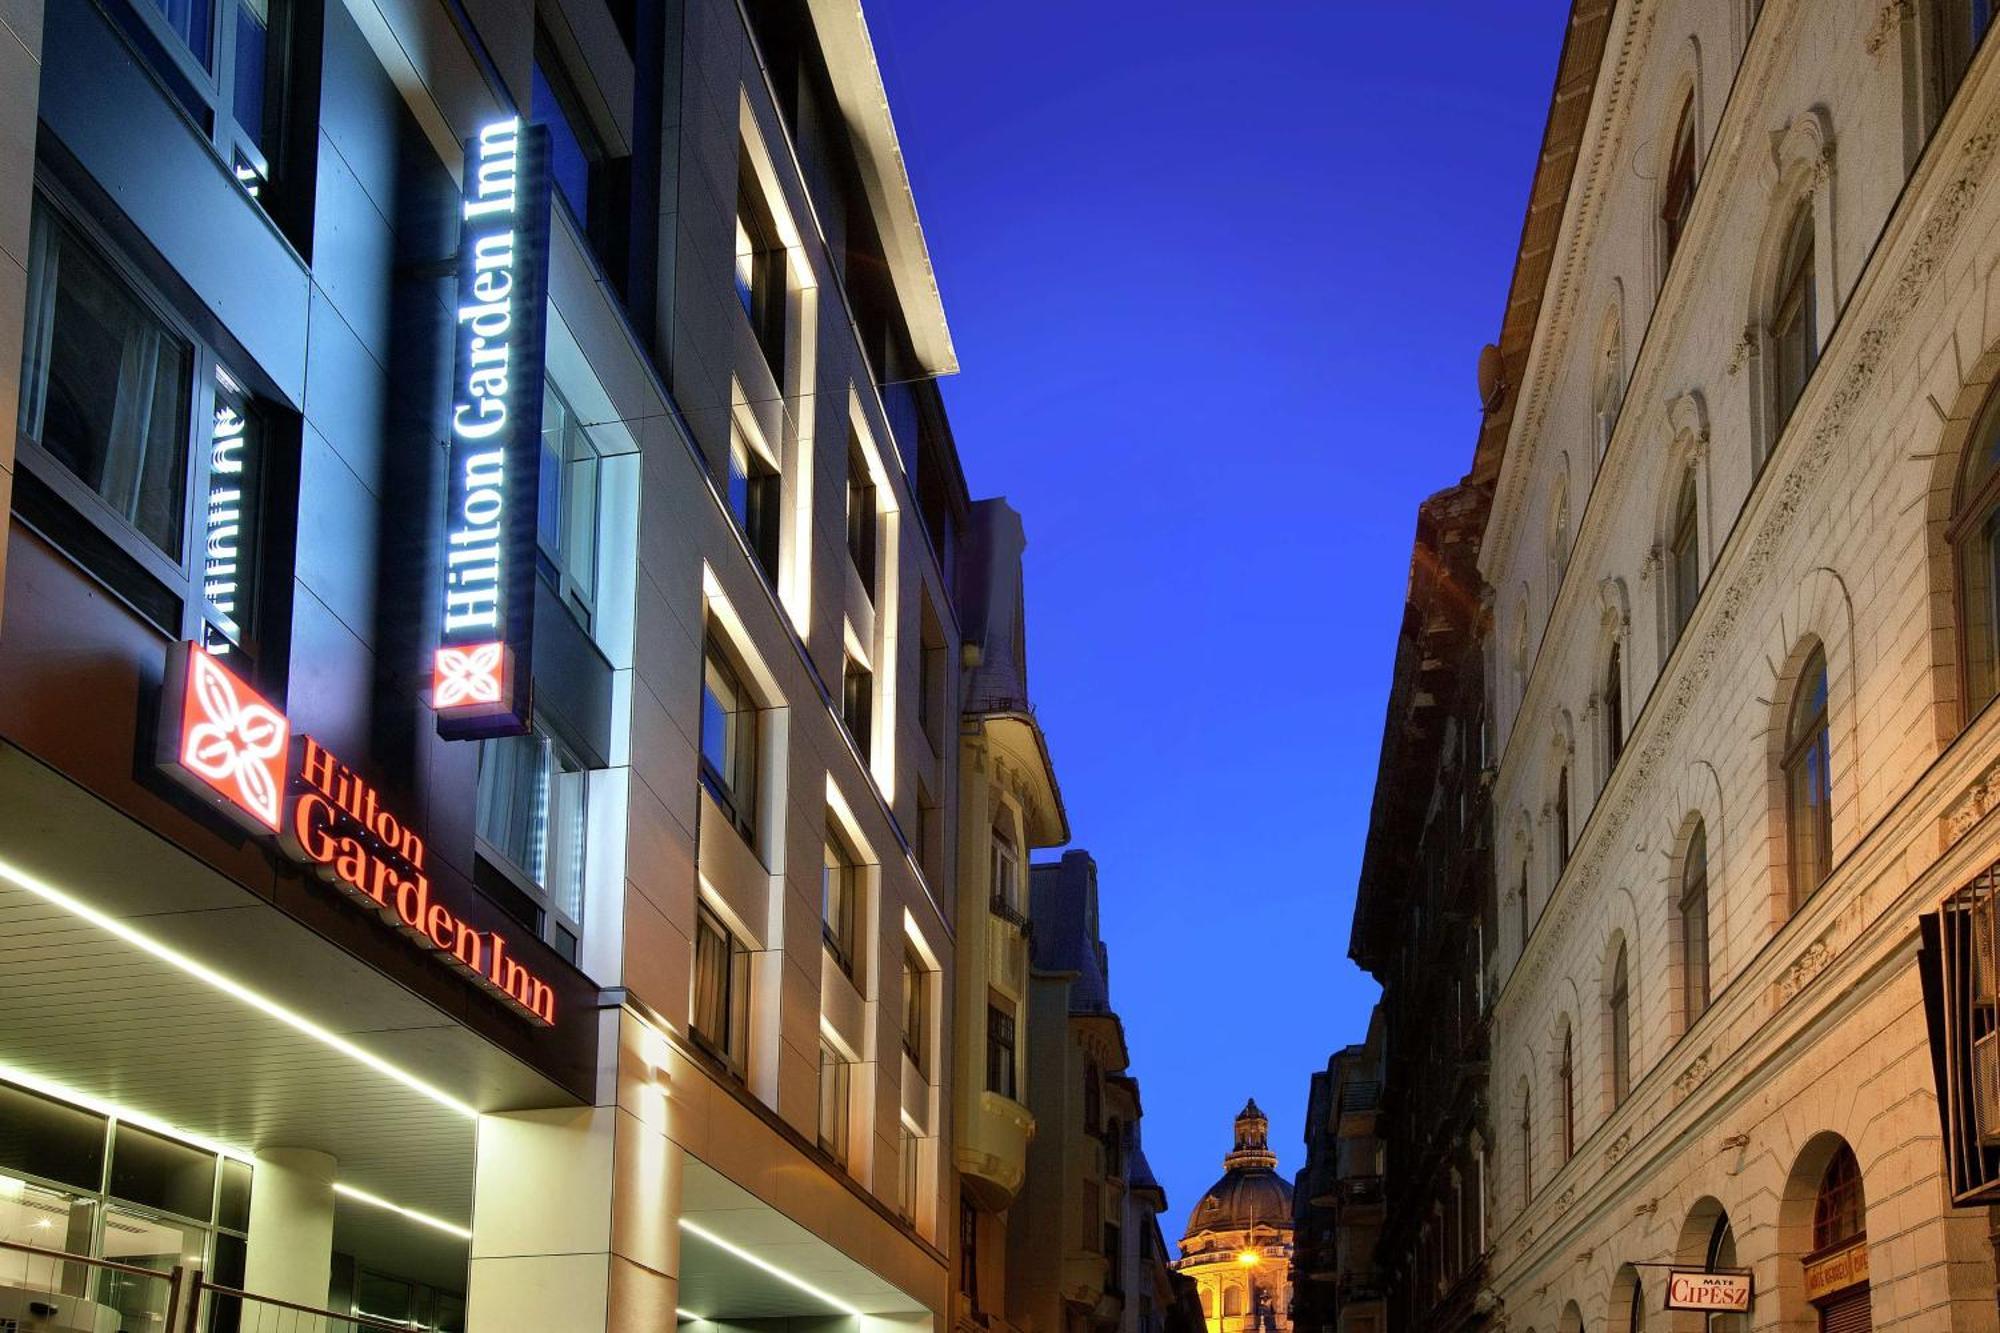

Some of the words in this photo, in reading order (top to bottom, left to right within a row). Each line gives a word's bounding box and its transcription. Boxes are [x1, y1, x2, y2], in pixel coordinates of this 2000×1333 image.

[464, 115, 518, 221] Inn
[453, 229, 514, 439] Garden
[445, 447, 504, 634] Hilton
[303, 737, 426, 870] Hilton
[296, 793, 484, 974] Garden
[486, 931, 556, 1026] Inn
